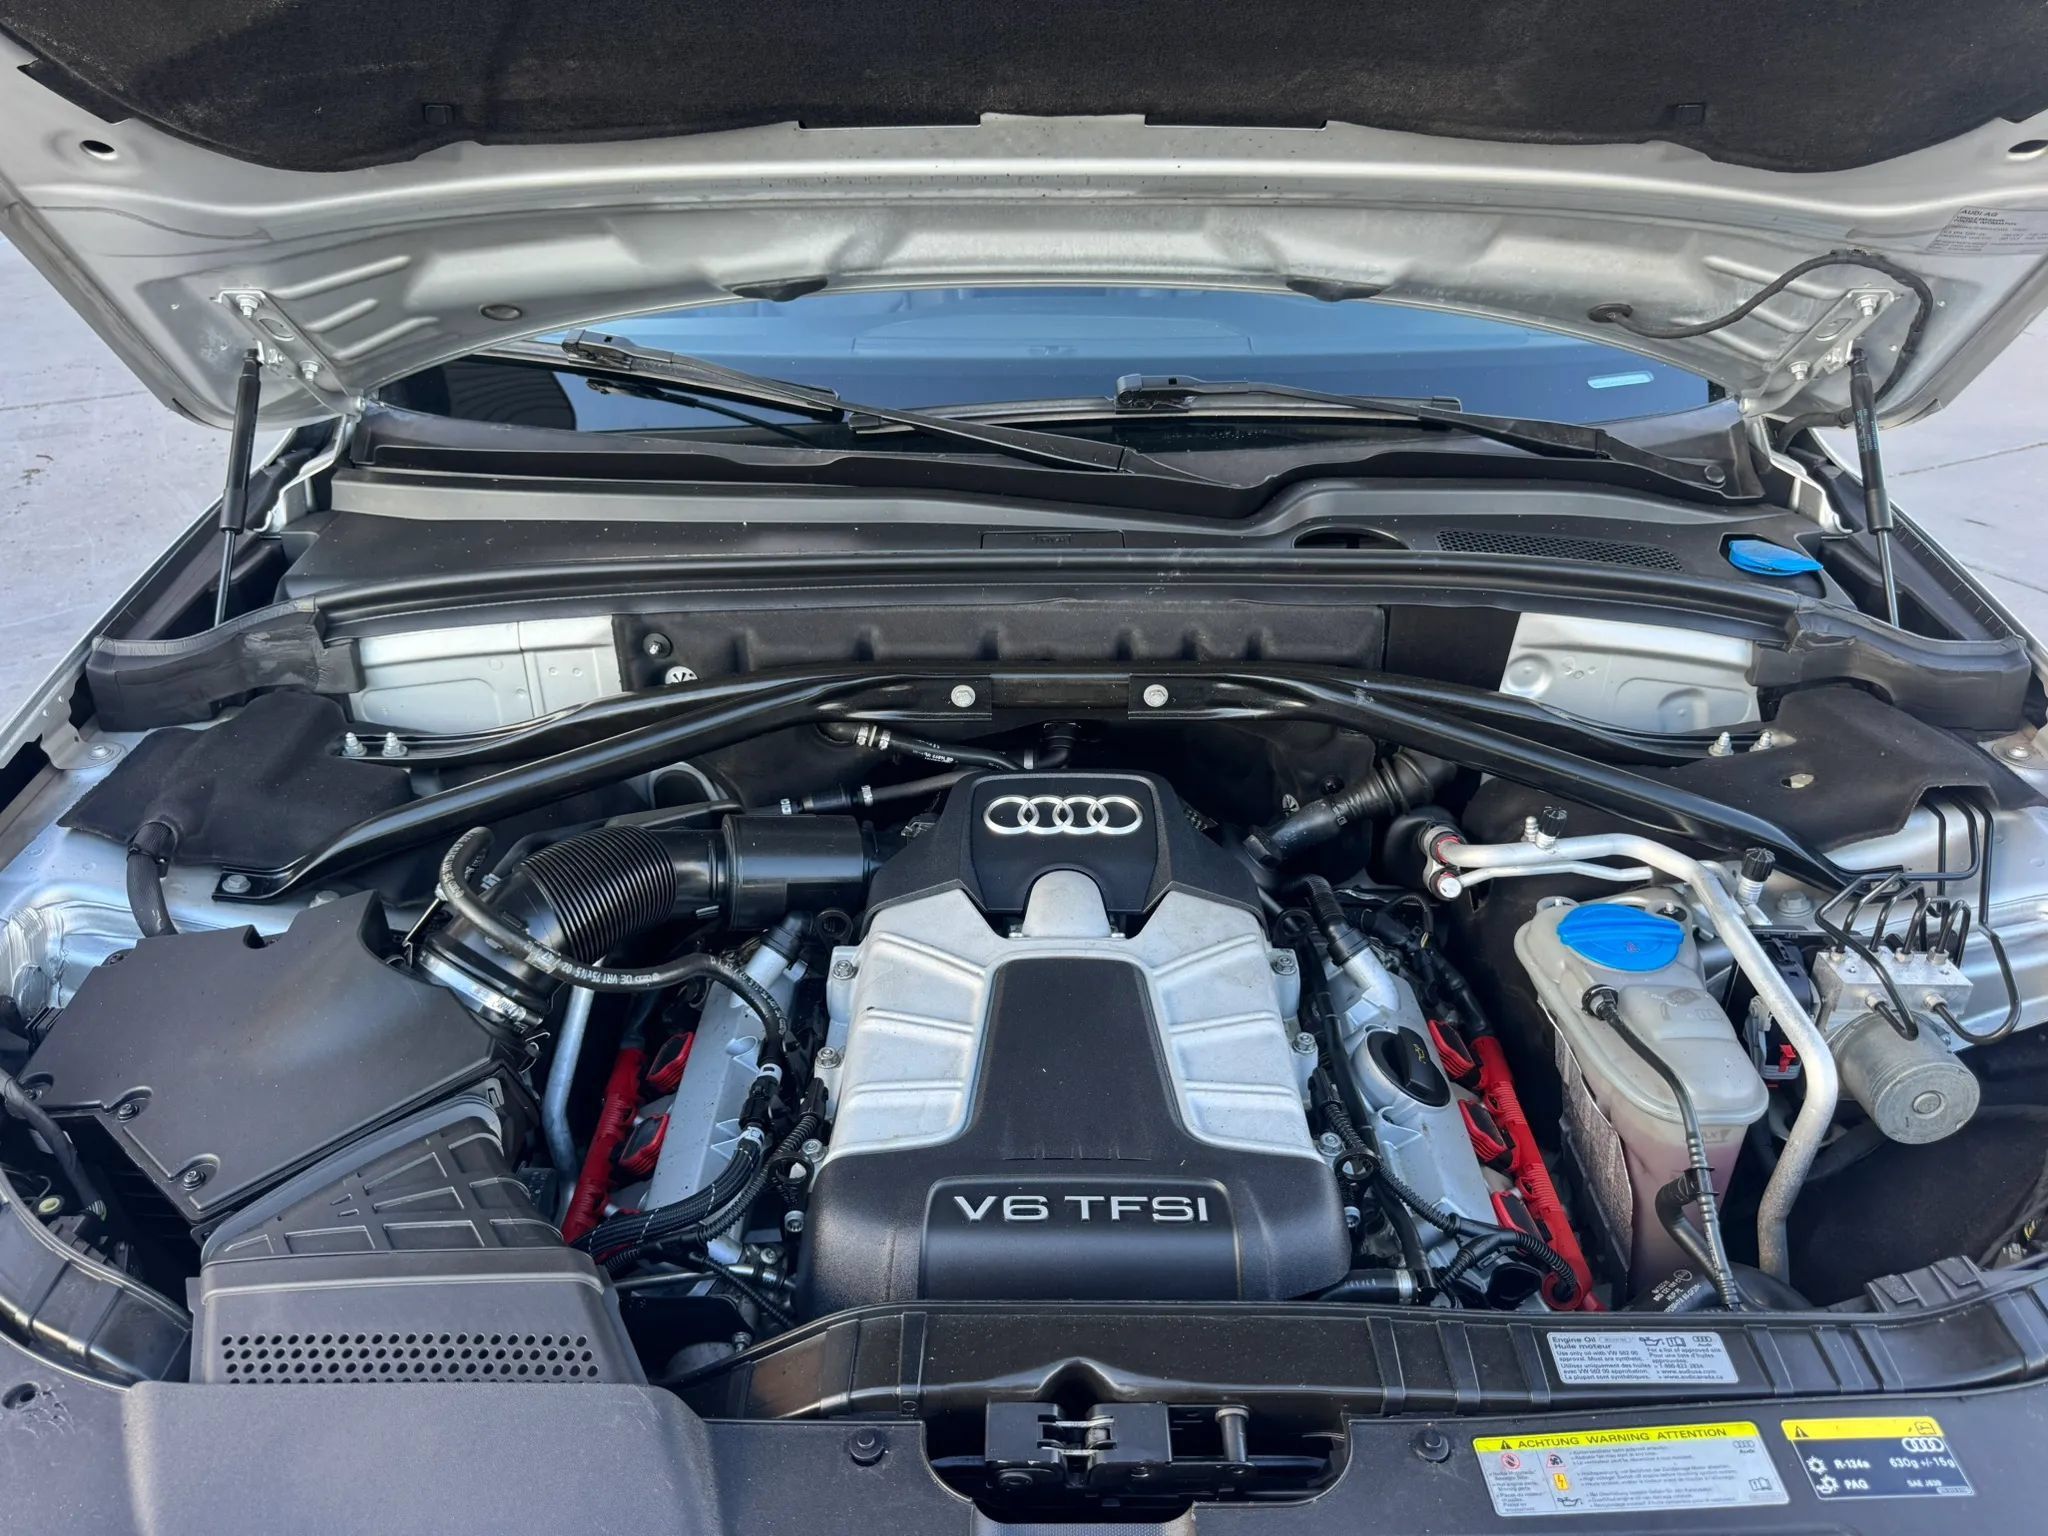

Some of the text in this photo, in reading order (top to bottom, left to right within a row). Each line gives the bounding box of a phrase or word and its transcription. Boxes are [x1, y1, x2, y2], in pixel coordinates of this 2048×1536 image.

[602, 973, 618, 984] VRT
[954, 1195, 1209, 1222] V6 TFSI
[1552, 1336, 1582, 1344] Engine
[1518, 1428, 1728, 1448] ACHTUNG WARNING ATTENTION
[1833, 1458, 1872, 1470] R-134a
[1888, 1456, 1920, 1470] 630g
[1844, 1479, 1870, 1490] PAG
[1906, 1479, 1924, 1488] SAE
